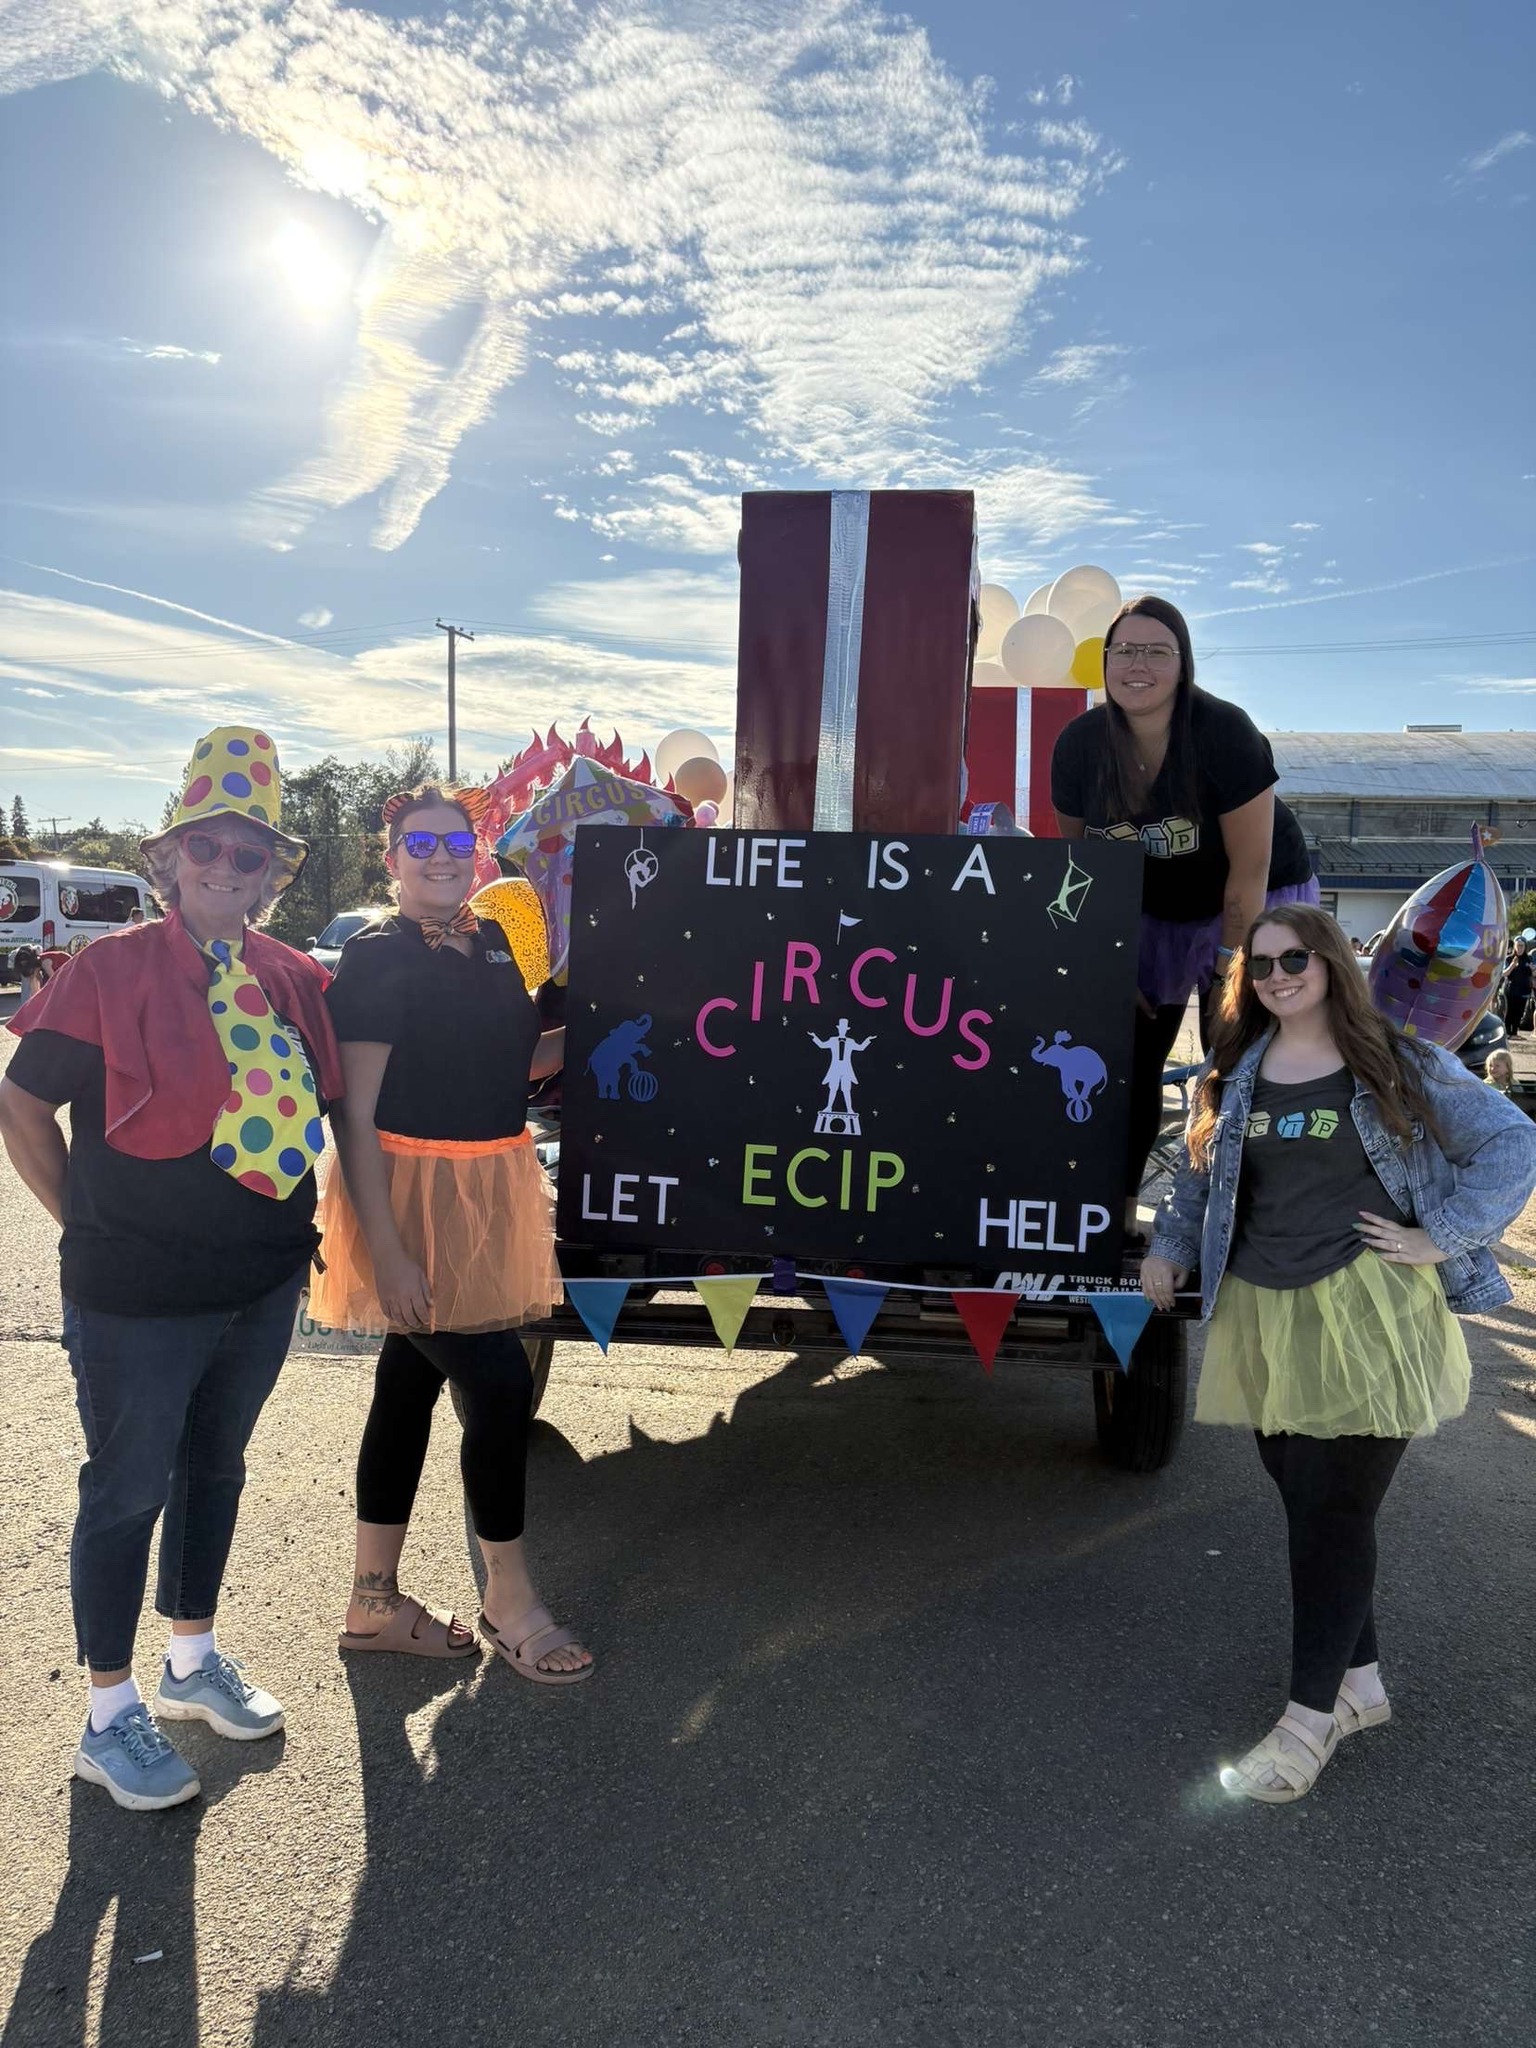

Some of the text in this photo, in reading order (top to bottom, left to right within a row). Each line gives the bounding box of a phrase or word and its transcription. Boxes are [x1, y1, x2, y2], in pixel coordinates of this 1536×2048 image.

[535, 781, 646, 825] CIRCUS
[704, 836, 997, 895] LIFE IS A
[695, 940, 994, 1071] CIRCUS
[581, 1143, 1112, 1254] LET ECIP HELP
[1068, 1274, 1113, 1285] TRUCK
